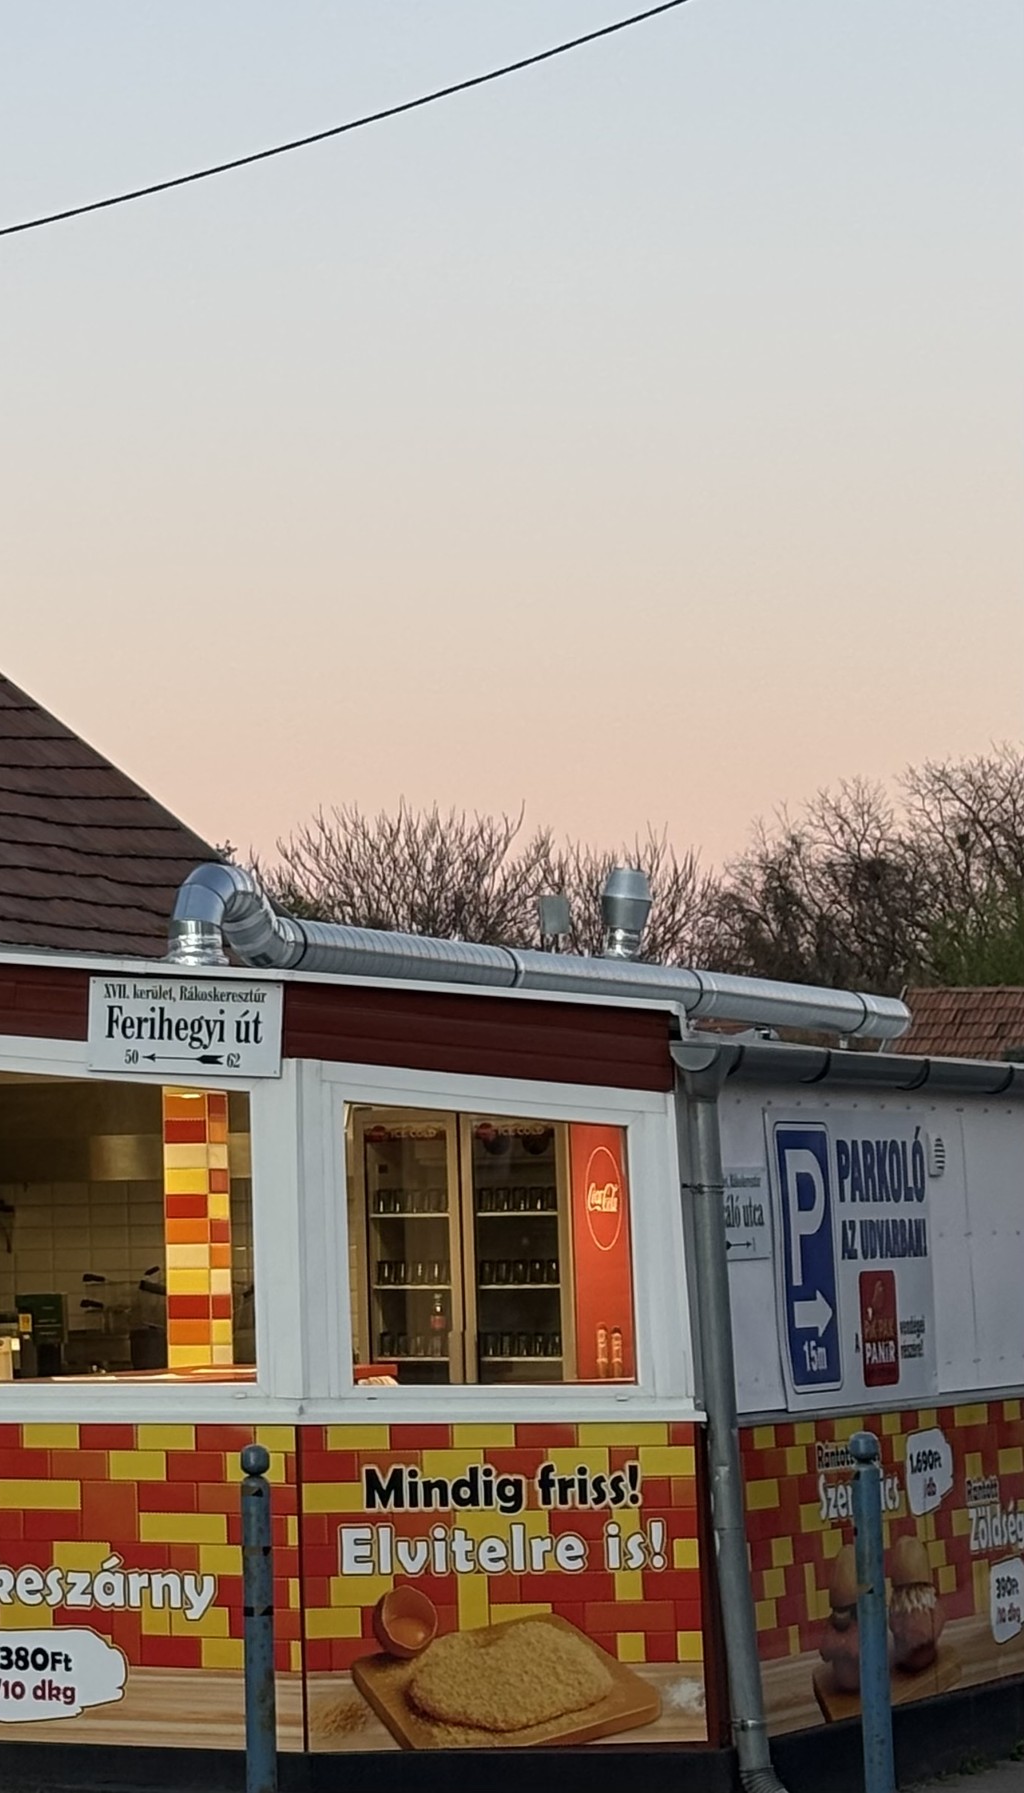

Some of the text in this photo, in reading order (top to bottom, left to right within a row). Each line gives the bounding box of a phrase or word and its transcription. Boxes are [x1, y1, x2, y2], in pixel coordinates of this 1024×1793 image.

[104, 984, 268, 1004] XVII. kerület, Rákoskeresztúr
[105, 1005, 264, 1050] Ferihegyi út
[124, 1049, 241, 1068] 50 62
[836, 1126, 925, 1203] PARKOLÓ
[742, 1196, 765, 1228] utca
[785, 1148, 826, 1286] P
[841, 1219, 858, 1260] AZ
[803, 1340, 828, 1372] 15m
[363, 1463, 640, 1513] Mindig friss!
[339, 1519, 668, 1576] Elvitelre is!
[32, 1679, 76, 1705] dkg
